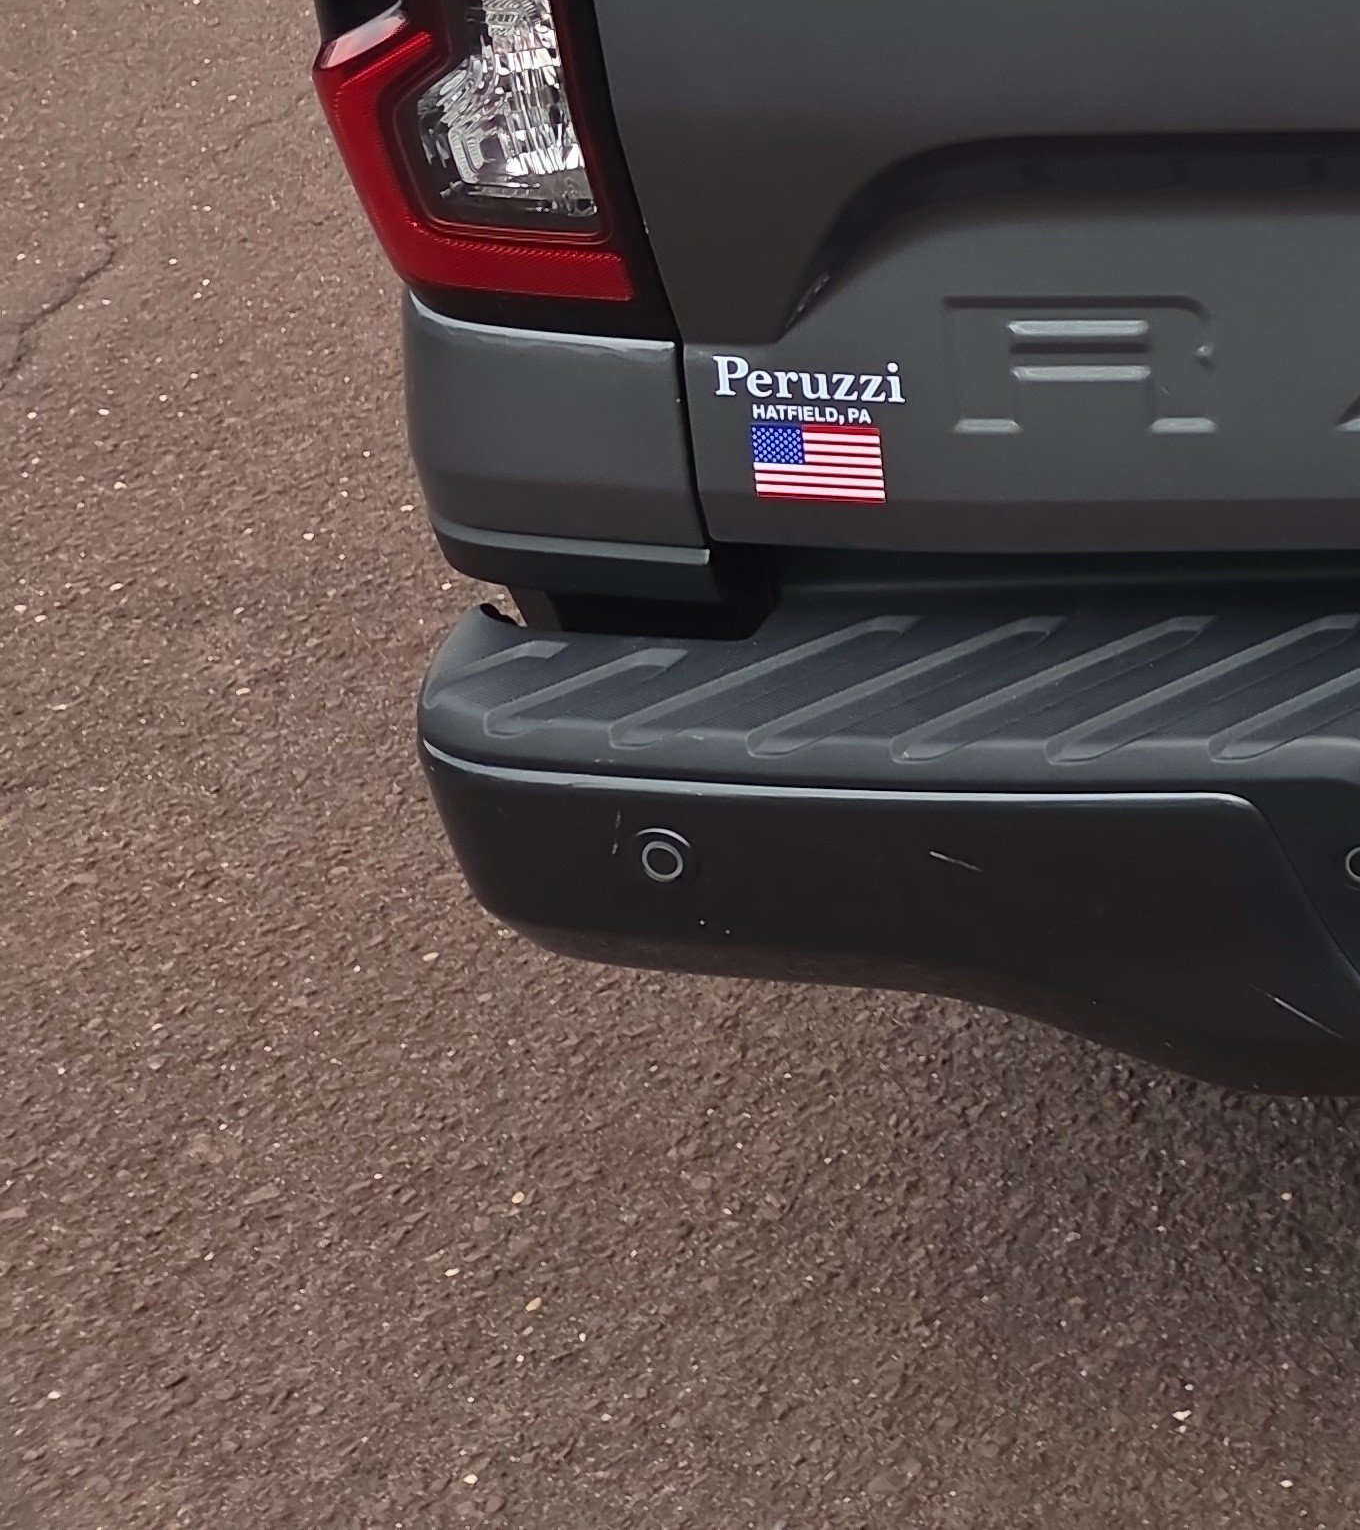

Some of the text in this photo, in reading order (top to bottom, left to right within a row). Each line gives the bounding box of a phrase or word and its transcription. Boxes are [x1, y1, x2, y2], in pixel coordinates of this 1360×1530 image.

[712, 354, 906, 404] Peruzzi
[752, 403, 872, 425] HATFIELD, PA
